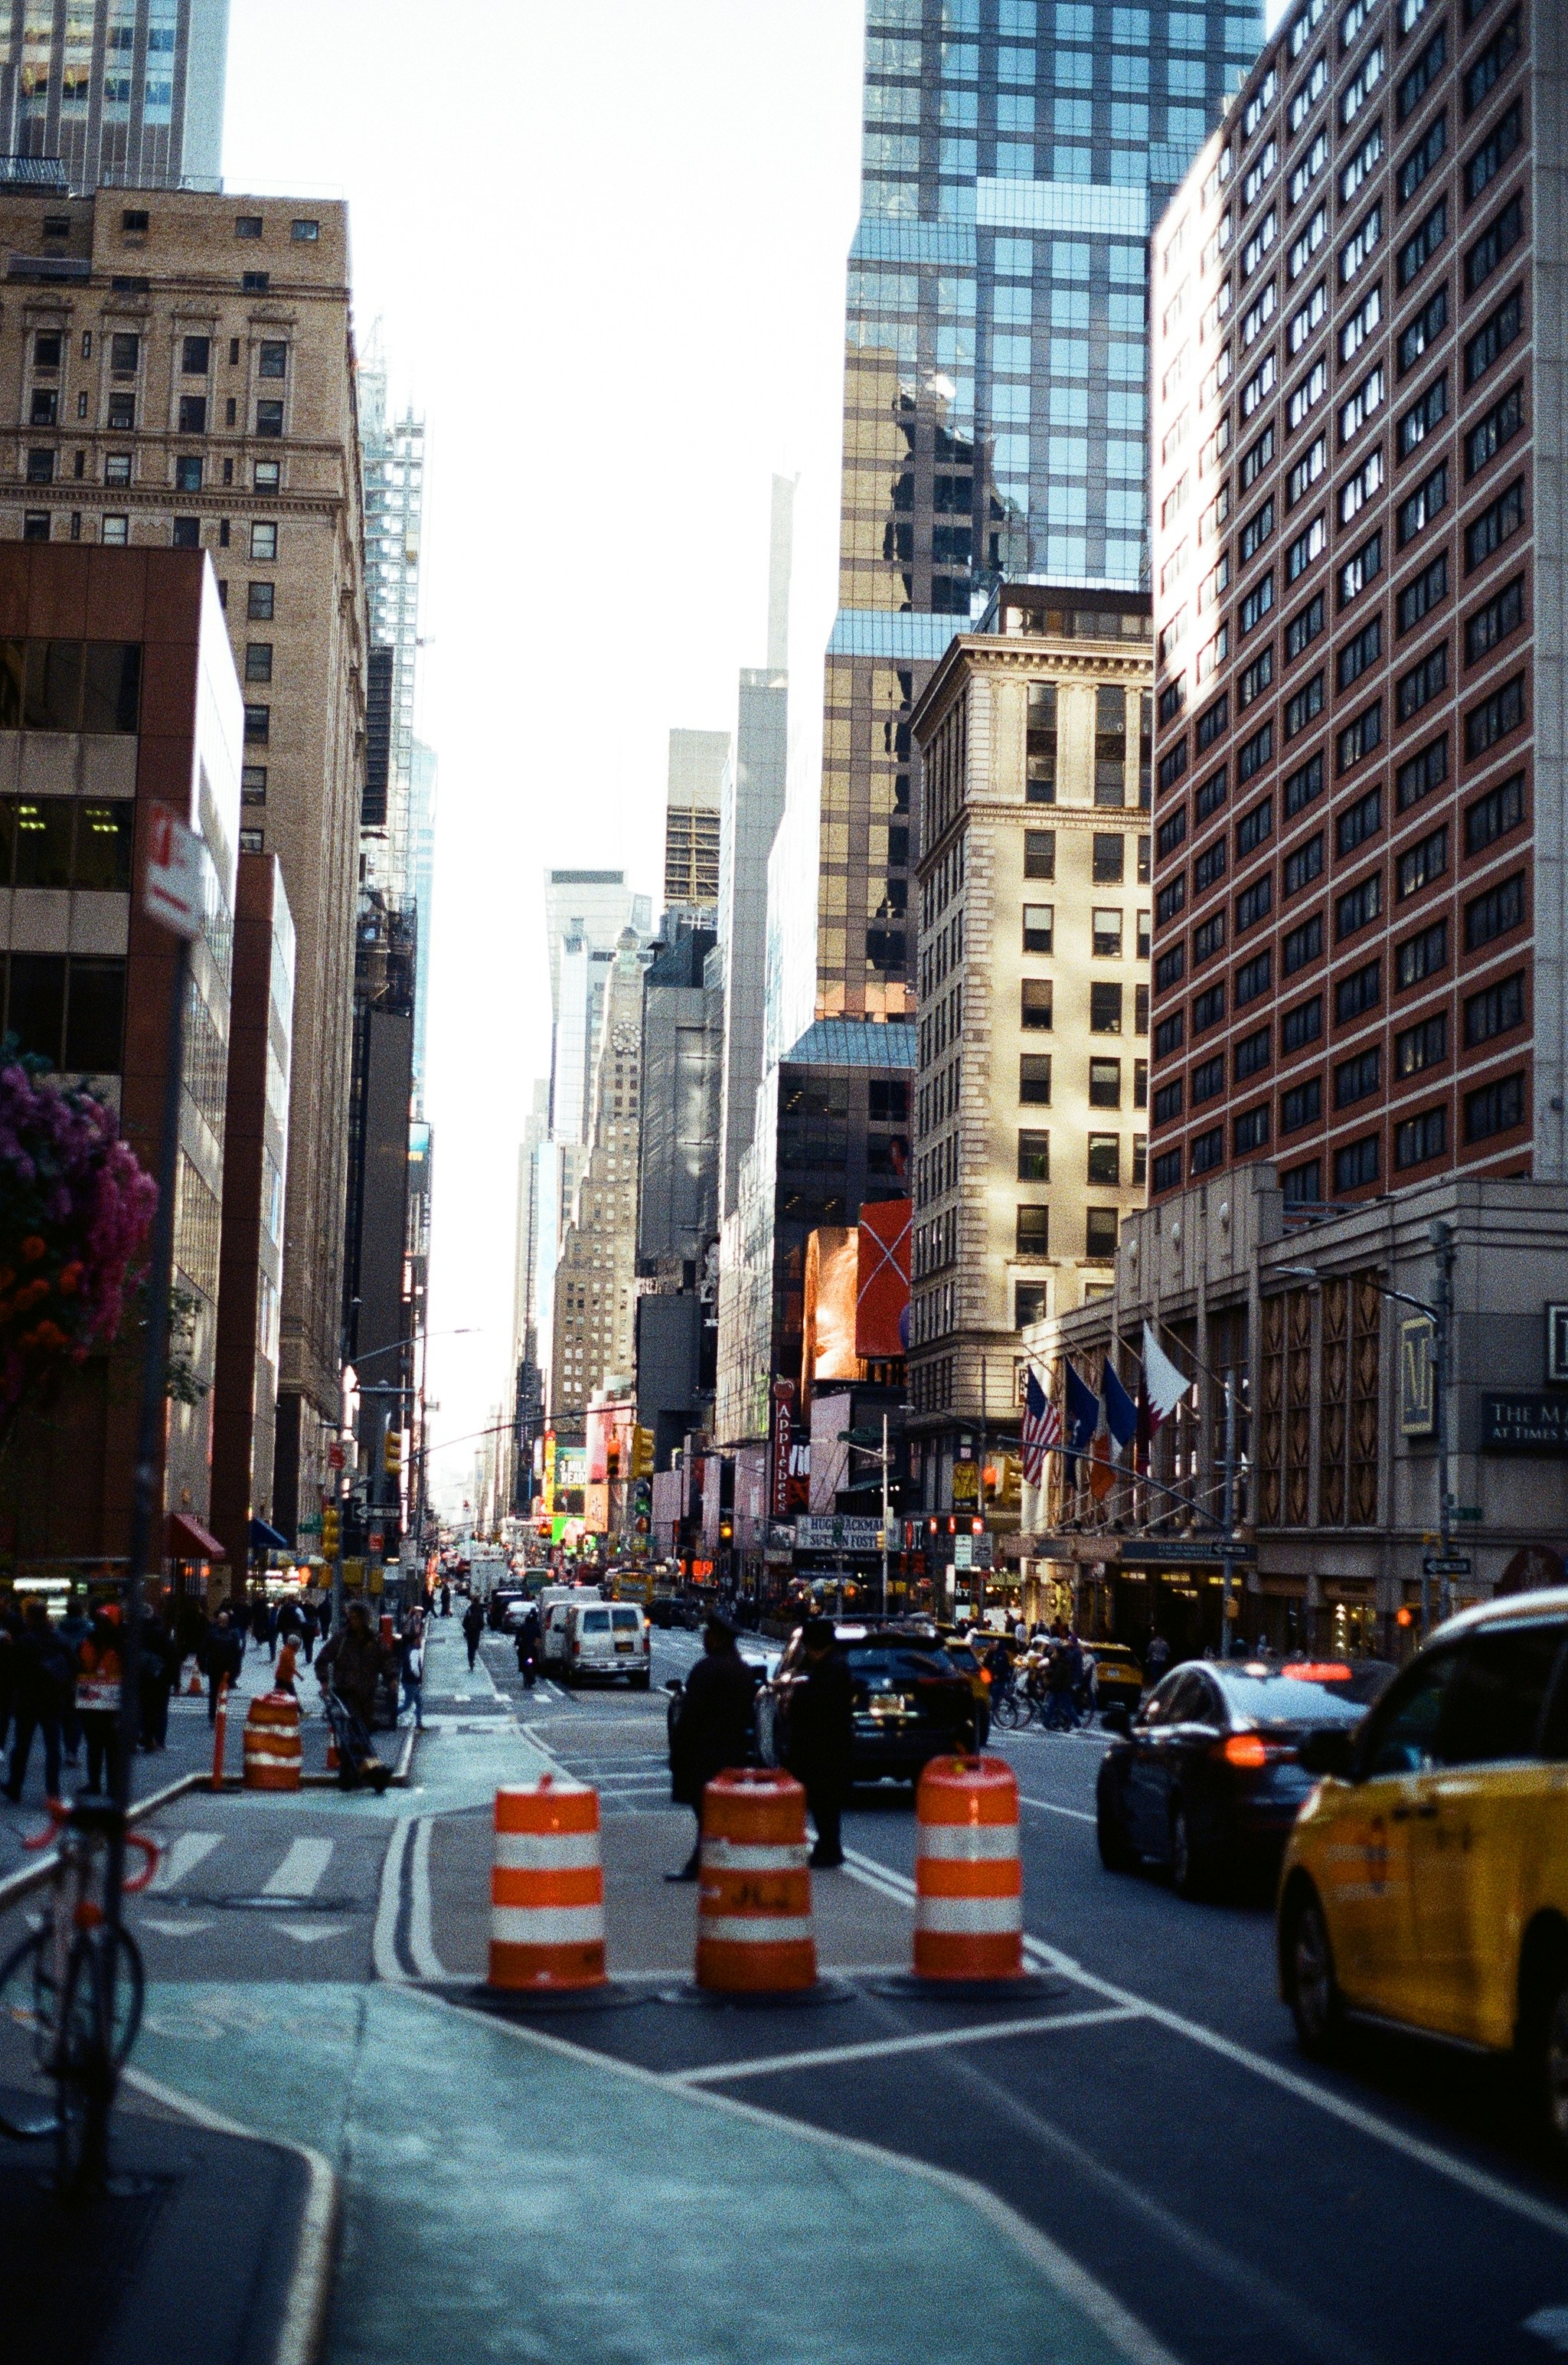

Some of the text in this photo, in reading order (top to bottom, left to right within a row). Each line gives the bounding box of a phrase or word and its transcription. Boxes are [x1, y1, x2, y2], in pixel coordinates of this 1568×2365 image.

[1491, 1403, 1531, 1423] THE
[1513, 1426, 1558, 1440] TIMES
[975, 1546, 991, 1557] 25
